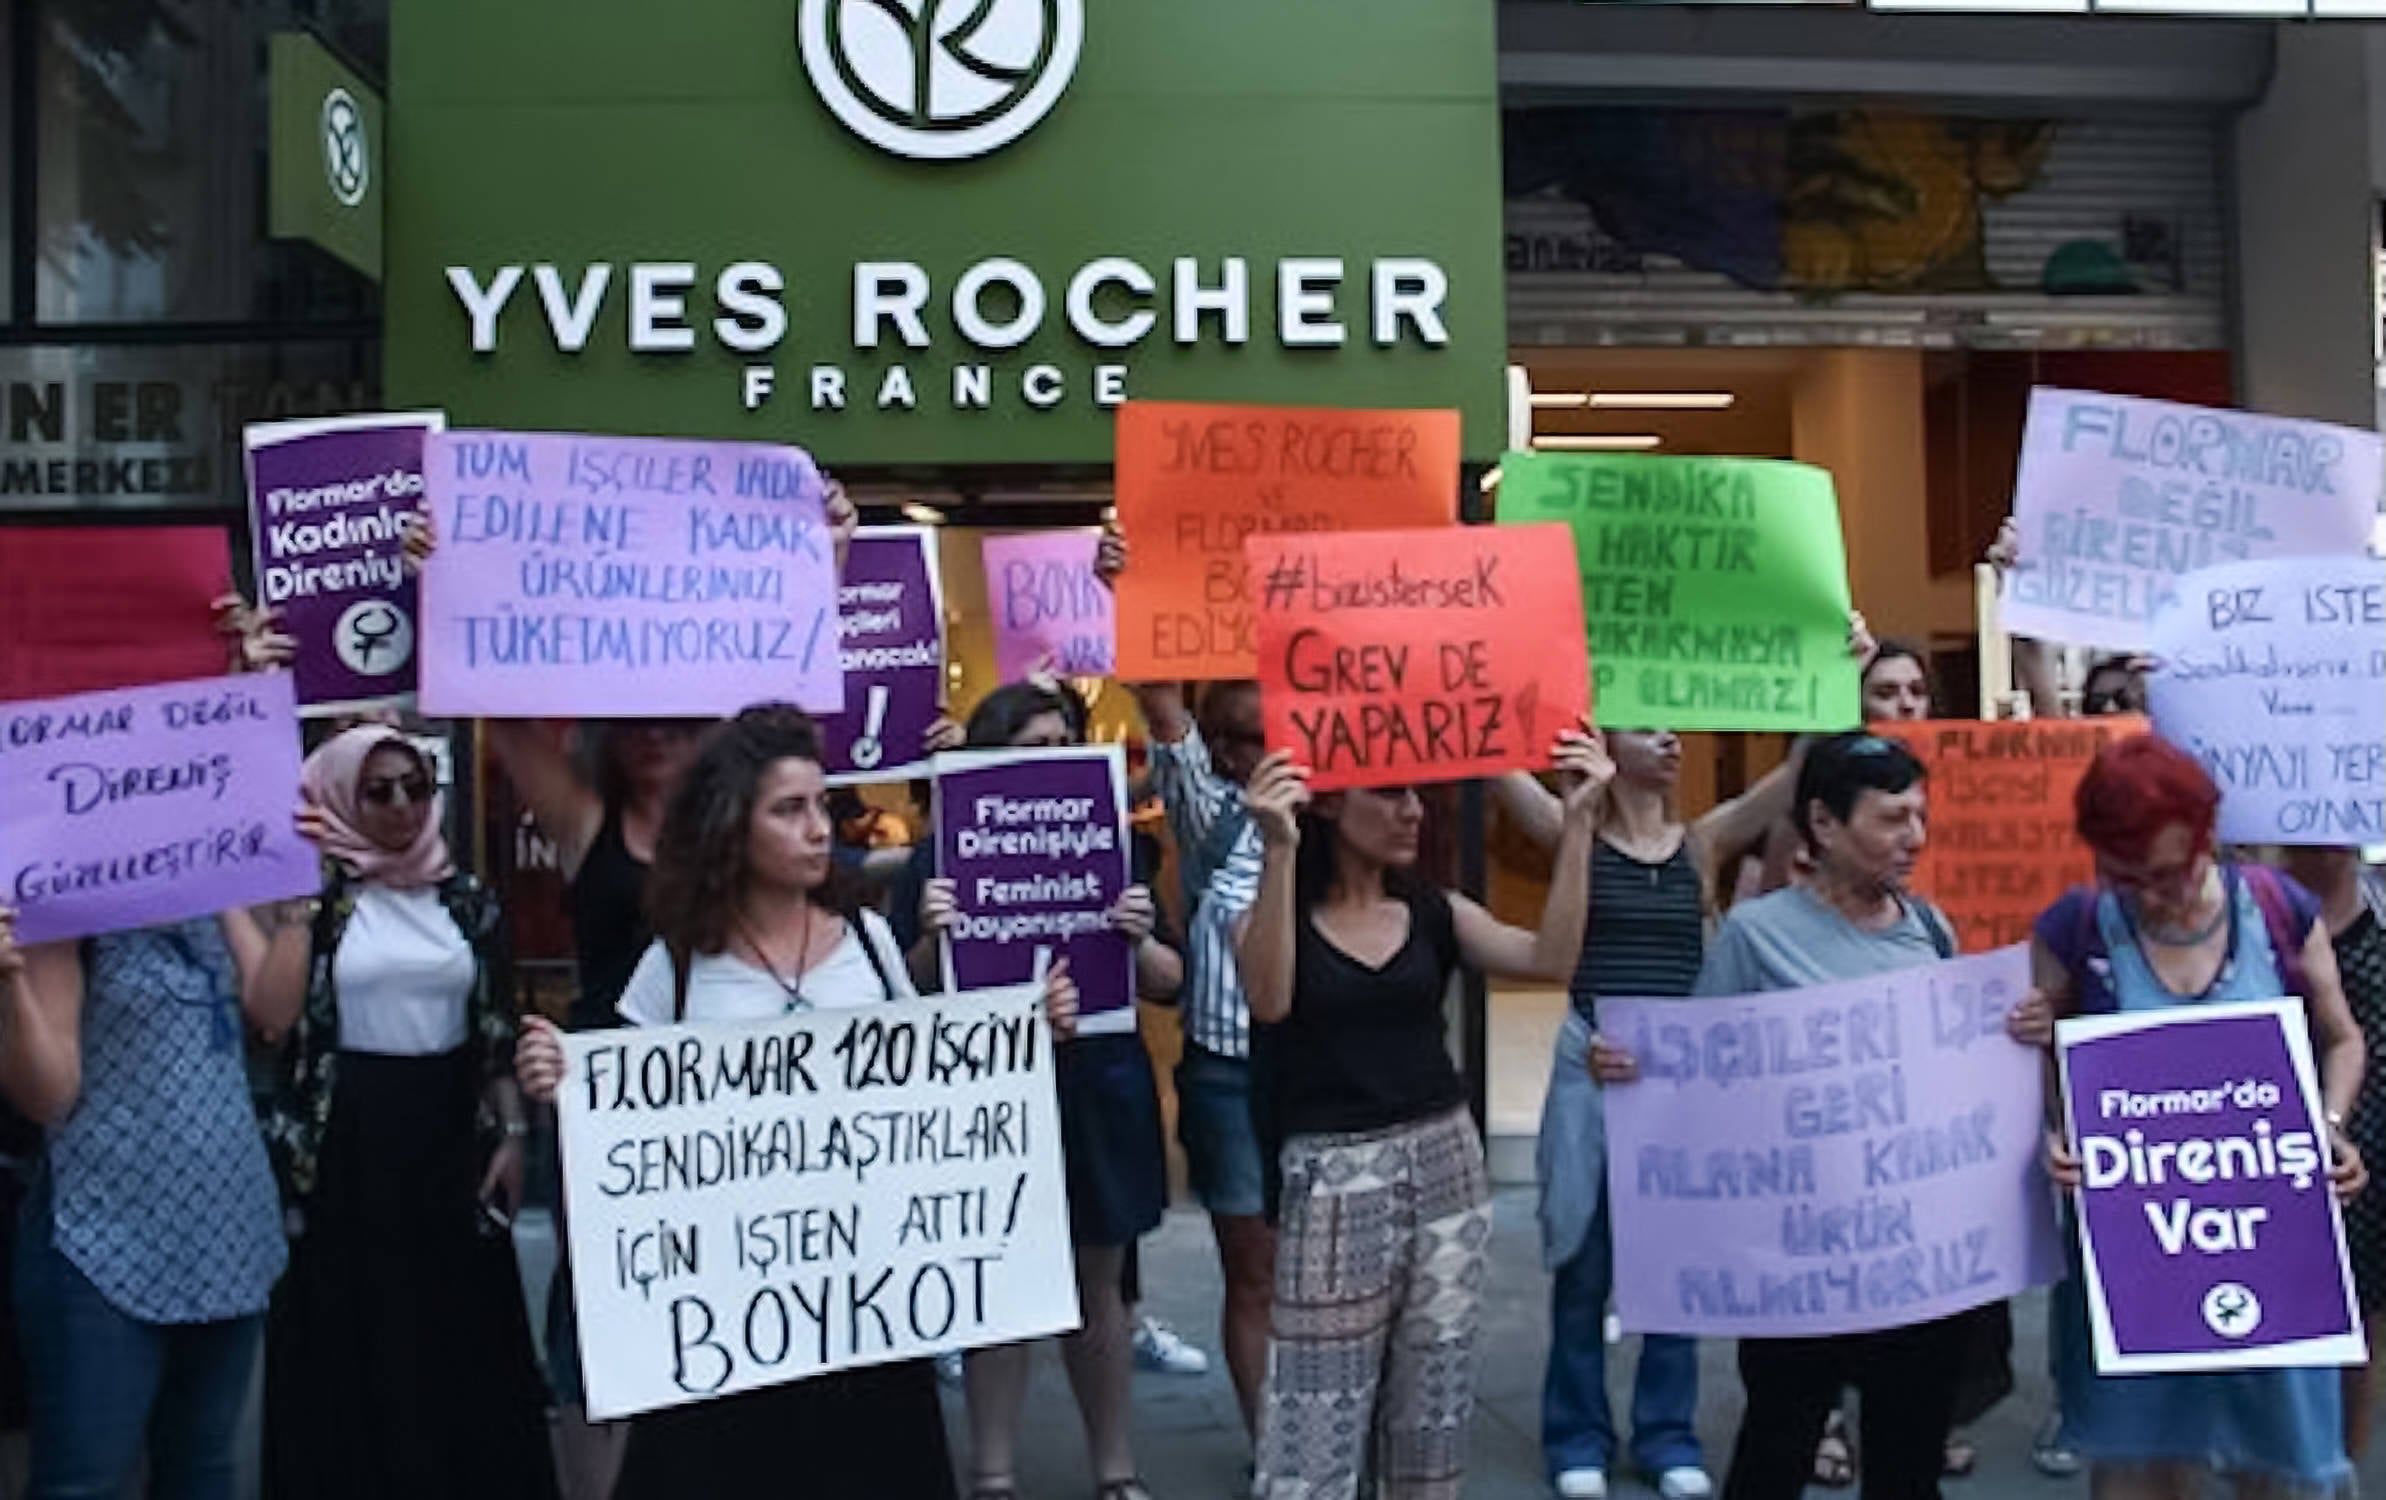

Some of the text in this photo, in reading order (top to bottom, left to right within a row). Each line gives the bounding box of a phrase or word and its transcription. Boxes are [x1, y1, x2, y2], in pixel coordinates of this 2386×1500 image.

[446, 257, 1450, 352] YVES ROCHER
[0, 382, 65, 441] N
[744, 363, 1130, 408] FRANCE
[2062, 402, 2345, 496] FLORMAR
[1437, 640, 1491, 693] DE
[975, 796, 1095, 825] Flormar
[584, 1028, 818, 1111] FLORMAR
[833, 1016, 917, 1091] 120
[2080, 1117, 2319, 1190] Direniş
[2144, 1198, 2269, 1255] Var
[669, 1254, 1004, 1396] BOYKOT
